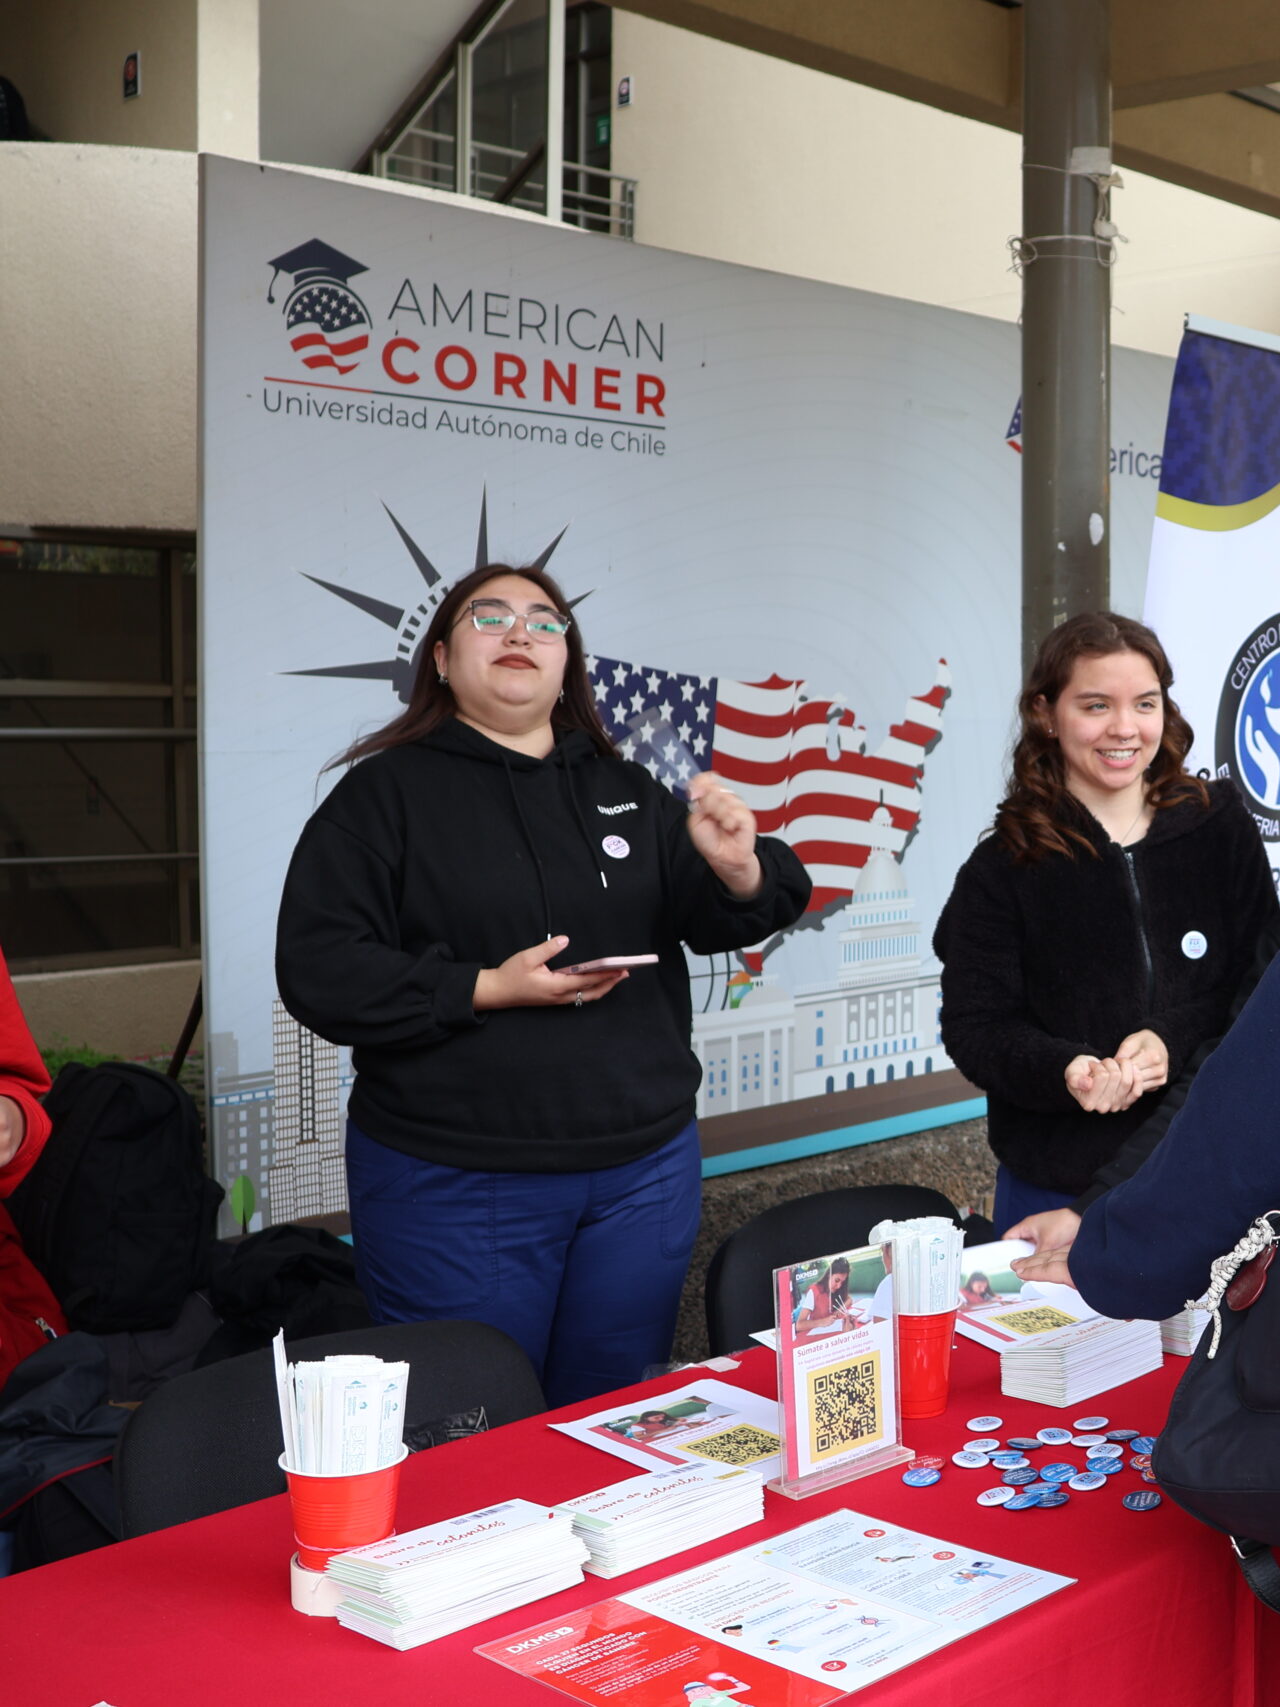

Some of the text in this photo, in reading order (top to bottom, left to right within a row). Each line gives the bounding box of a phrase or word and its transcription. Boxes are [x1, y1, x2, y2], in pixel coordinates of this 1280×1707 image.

[388, 278, 664, 362] AMERICAN
[381, 337, 666, 417] CORNER
[263, 388, 666, 456] Universidad Autónoma de Chile
[1109, 442, 1162, 480] erica
[1230, 627, 1277, 690] CENTRO
[797, 1343, 823, 1357] Súmate
[830, 1336, 850, 1347] salvar
[852, 1330, 869, 1341] vidas
[505, 1631, 560, 1654] DKMS
